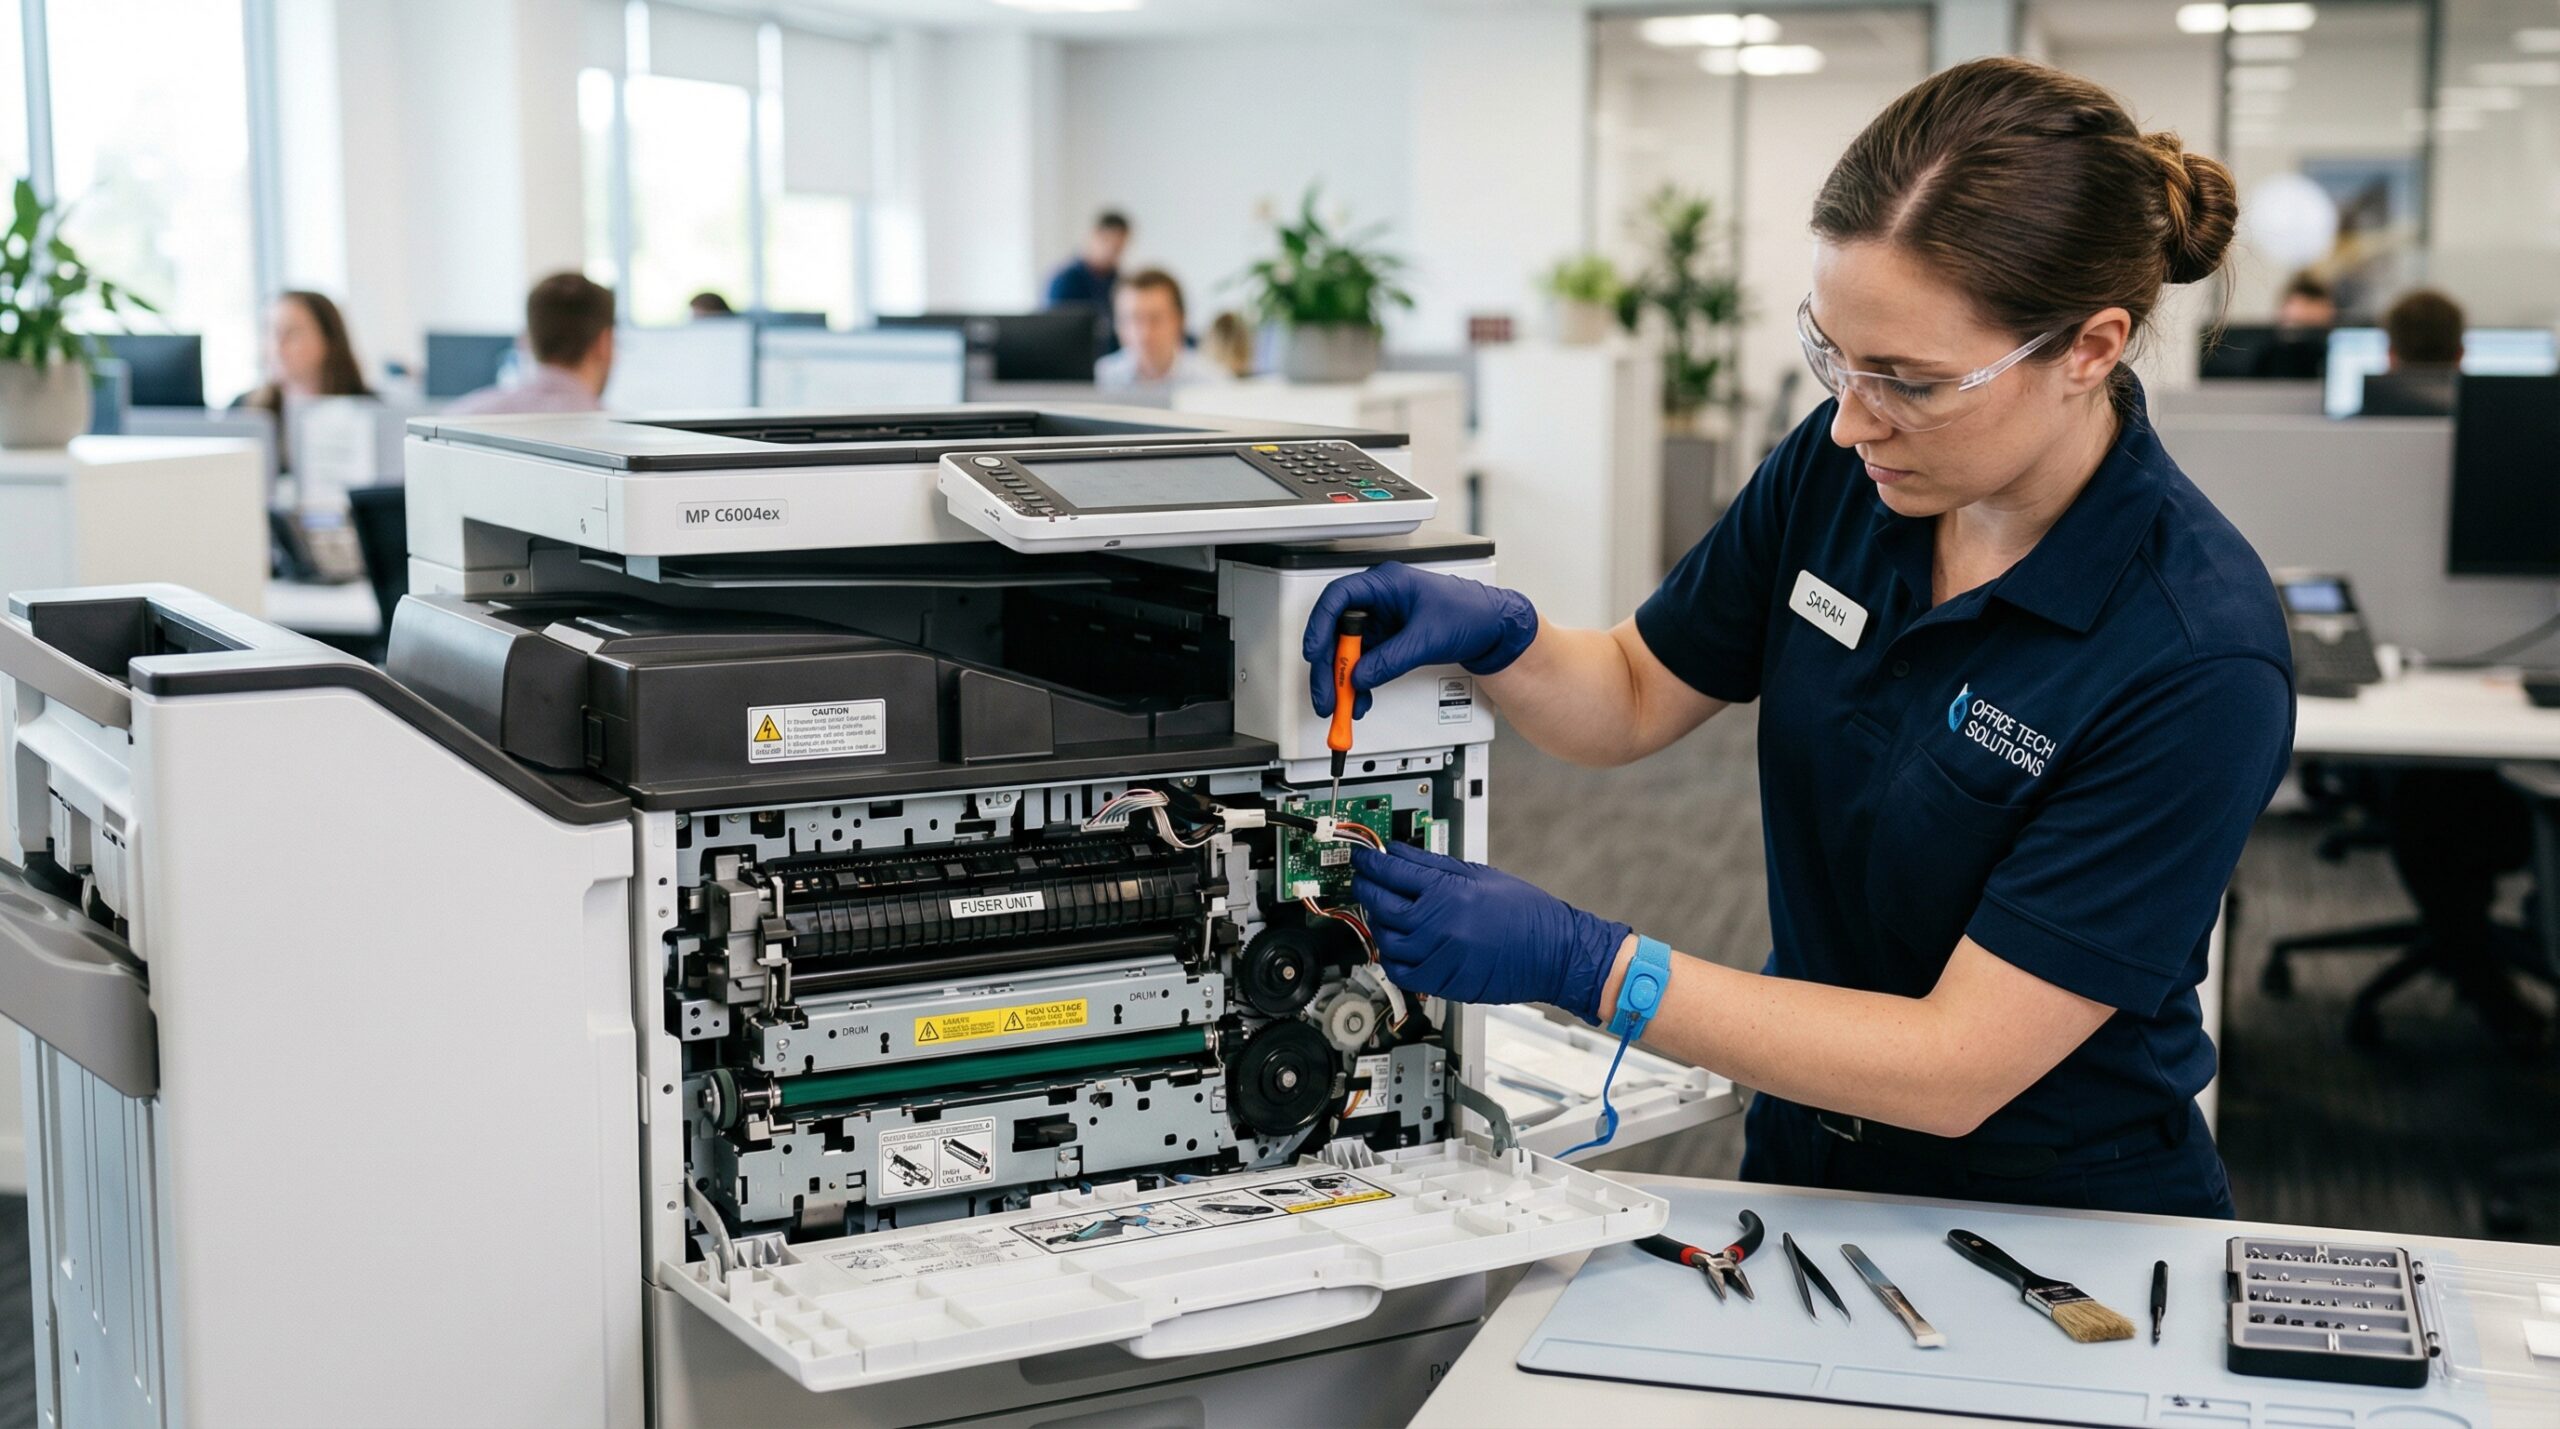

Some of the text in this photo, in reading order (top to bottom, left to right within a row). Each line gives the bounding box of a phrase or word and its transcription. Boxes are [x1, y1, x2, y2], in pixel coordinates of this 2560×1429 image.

[686, 507, 780, 523] MP C6004ex
[1806, 590, 1847, 626] SARAH
[812, 707, 849, 716] CAUTION
[1971, 699, 2056, 760] OFFICE TECH
[1965, 720, 2045, 777] SOLUTIONS
[960, 895, 1034, 914] FUSER UNIT
[1130, 991, 1156, 1001] DRUM
[842, 1025, 869, 1036] DRUM
